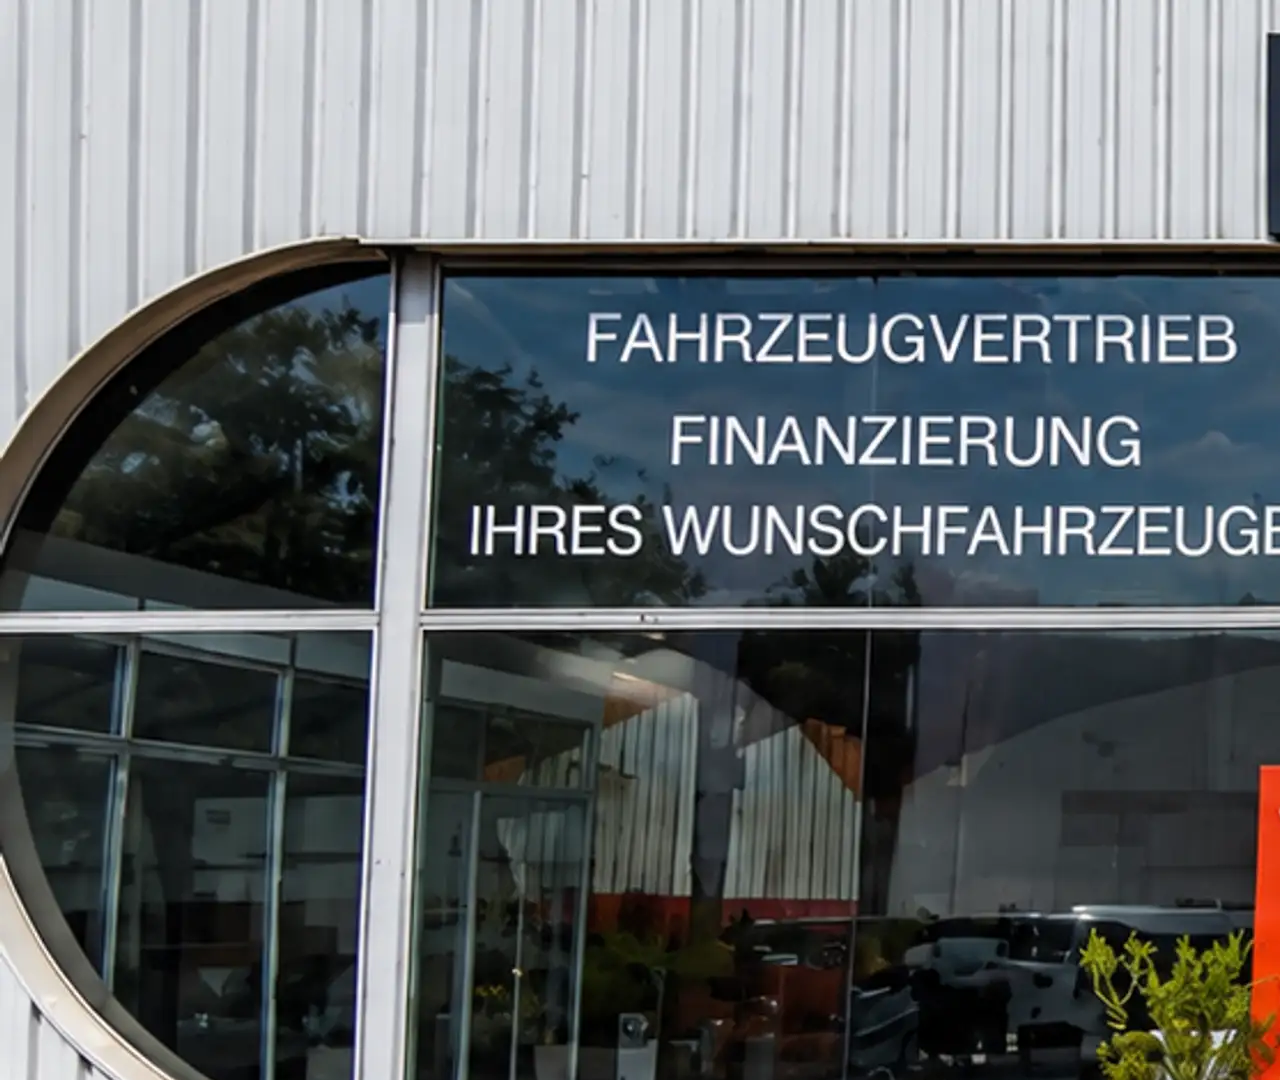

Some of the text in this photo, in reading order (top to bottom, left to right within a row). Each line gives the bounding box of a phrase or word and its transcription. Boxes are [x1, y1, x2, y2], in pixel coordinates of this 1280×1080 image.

[584, 311, 1239, 365] FAHRZEUGVERTRIEB
[669, 414, 1143, 468] FINANZIERUNG
[468, 503, 644, 556] IHRES
